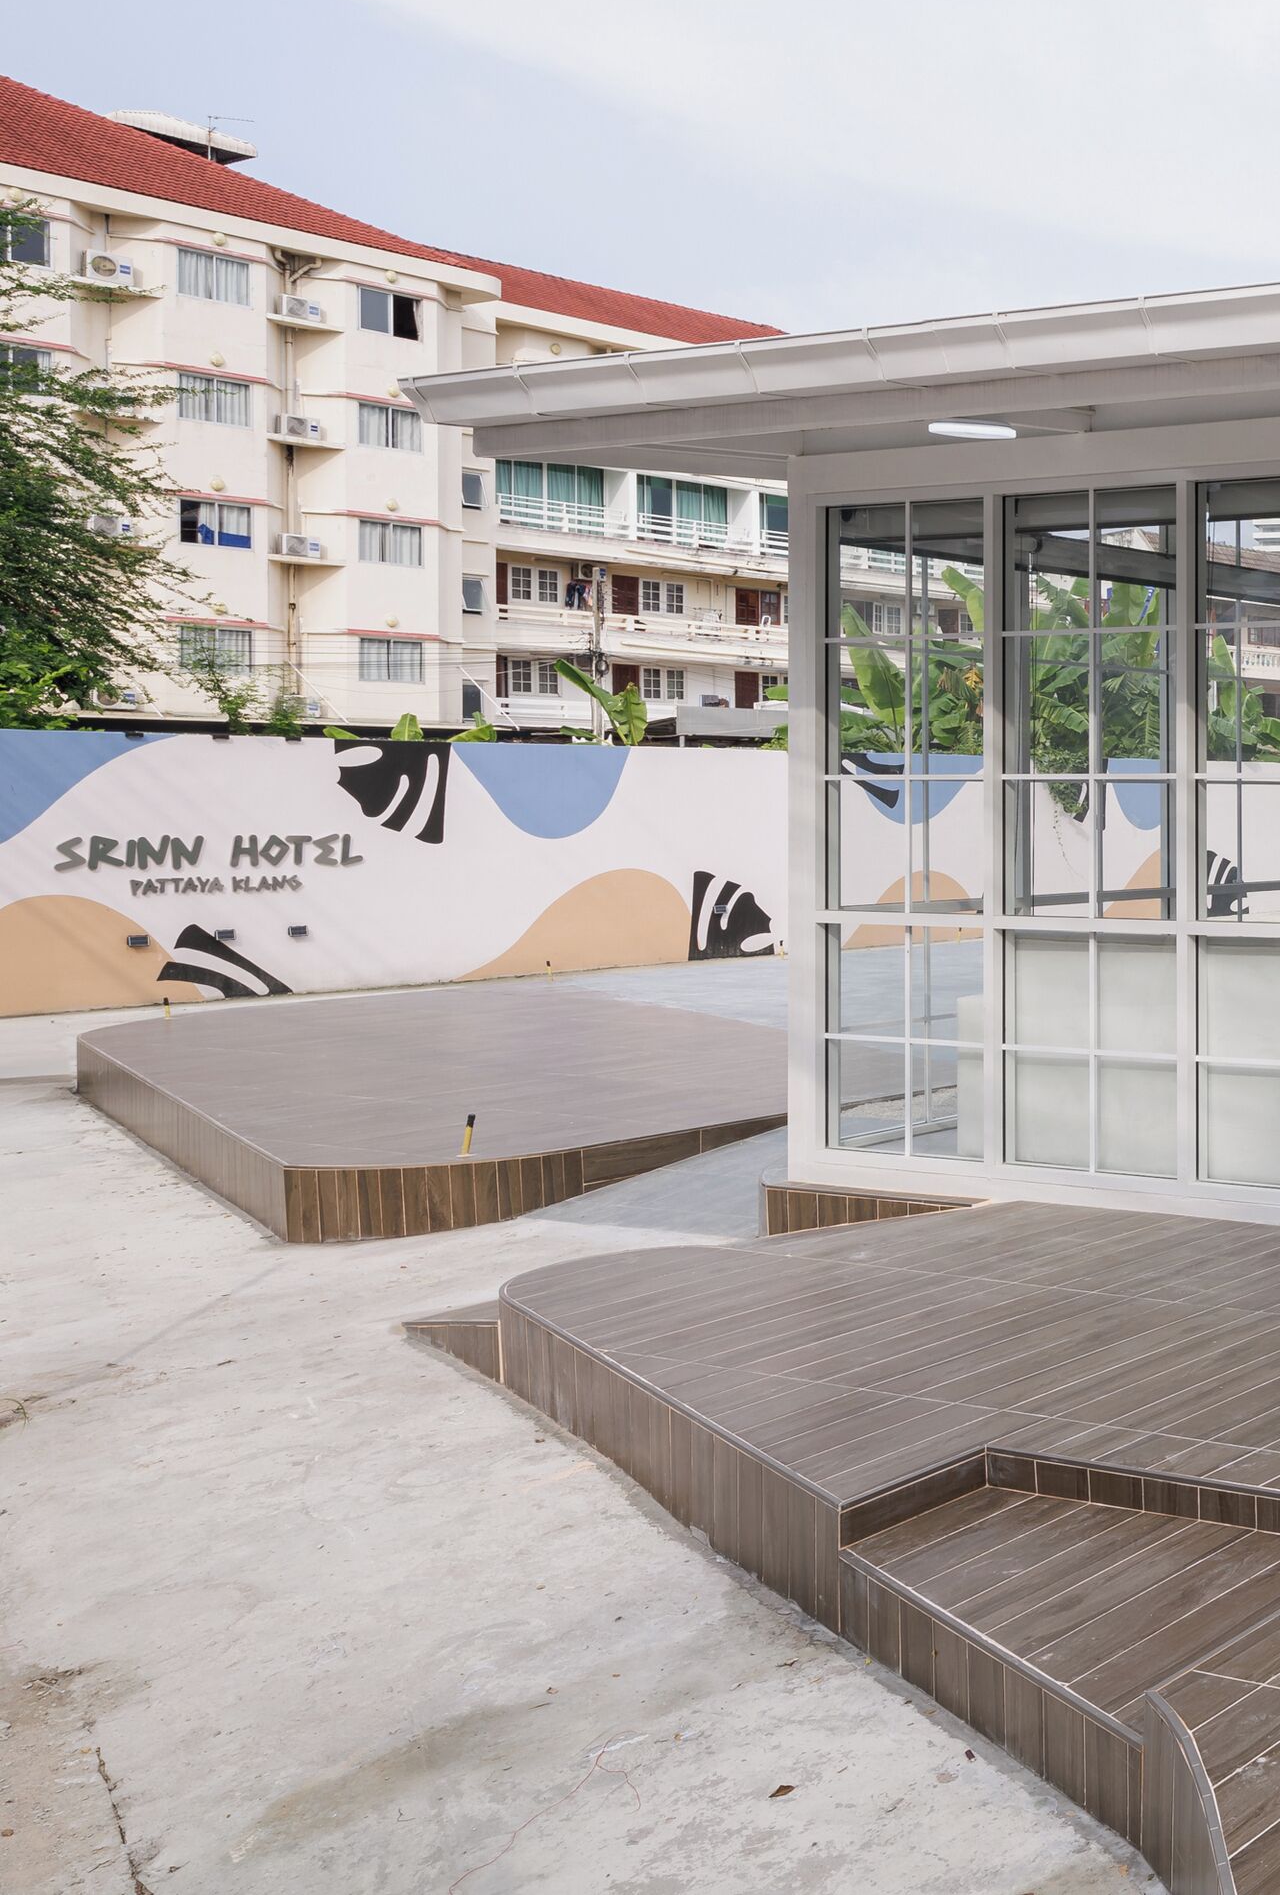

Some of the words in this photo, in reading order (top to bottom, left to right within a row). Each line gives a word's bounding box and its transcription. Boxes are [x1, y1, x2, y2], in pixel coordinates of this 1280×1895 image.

[54, 834, 205, 871] SRINN
[230, 833, 363, 867] HOTEL
[129, 876, 224, 896] PATTAYA
[232, 874, 303, 893] KLANG
